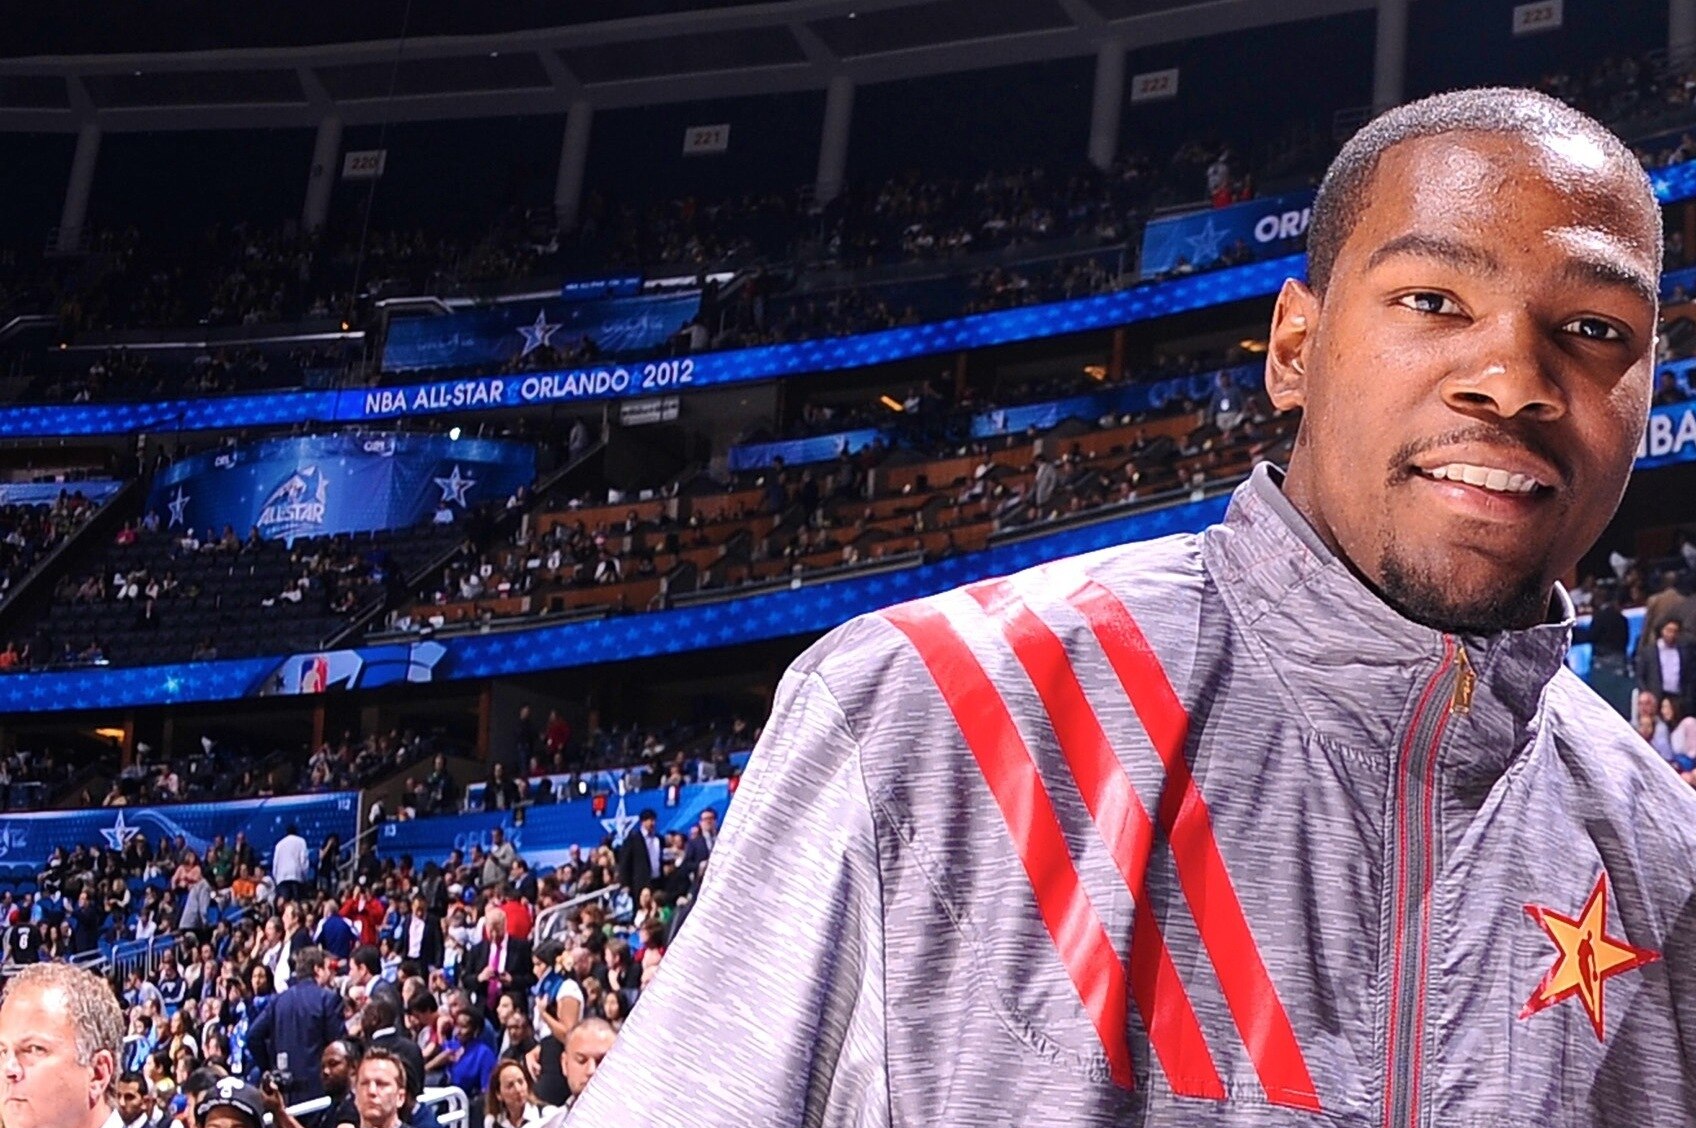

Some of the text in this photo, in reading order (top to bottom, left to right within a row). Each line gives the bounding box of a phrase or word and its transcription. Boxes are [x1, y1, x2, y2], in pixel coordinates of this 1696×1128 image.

[694, 131, 720, 146] 221
[365, 359, 694, 415] NBA ALL-STAR ORLANDO 2012
